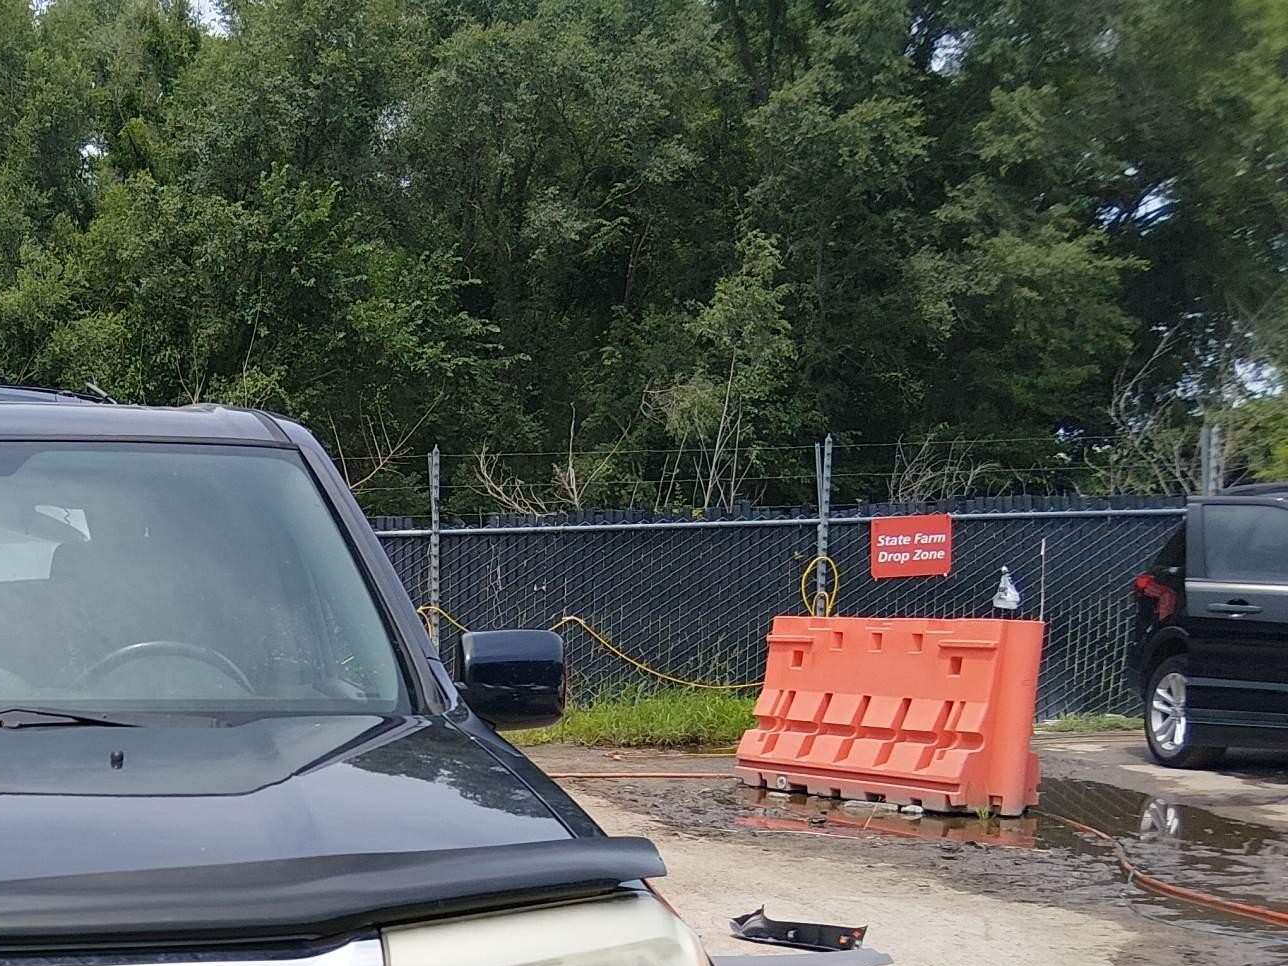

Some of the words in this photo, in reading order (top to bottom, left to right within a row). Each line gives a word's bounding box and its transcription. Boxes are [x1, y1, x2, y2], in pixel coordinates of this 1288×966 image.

[876, 534, 912, 547] State
[914, 532, 946, 545] Farm
[878, 551, 910, 564] Drop
[912, 549, 945, 561] Zone
